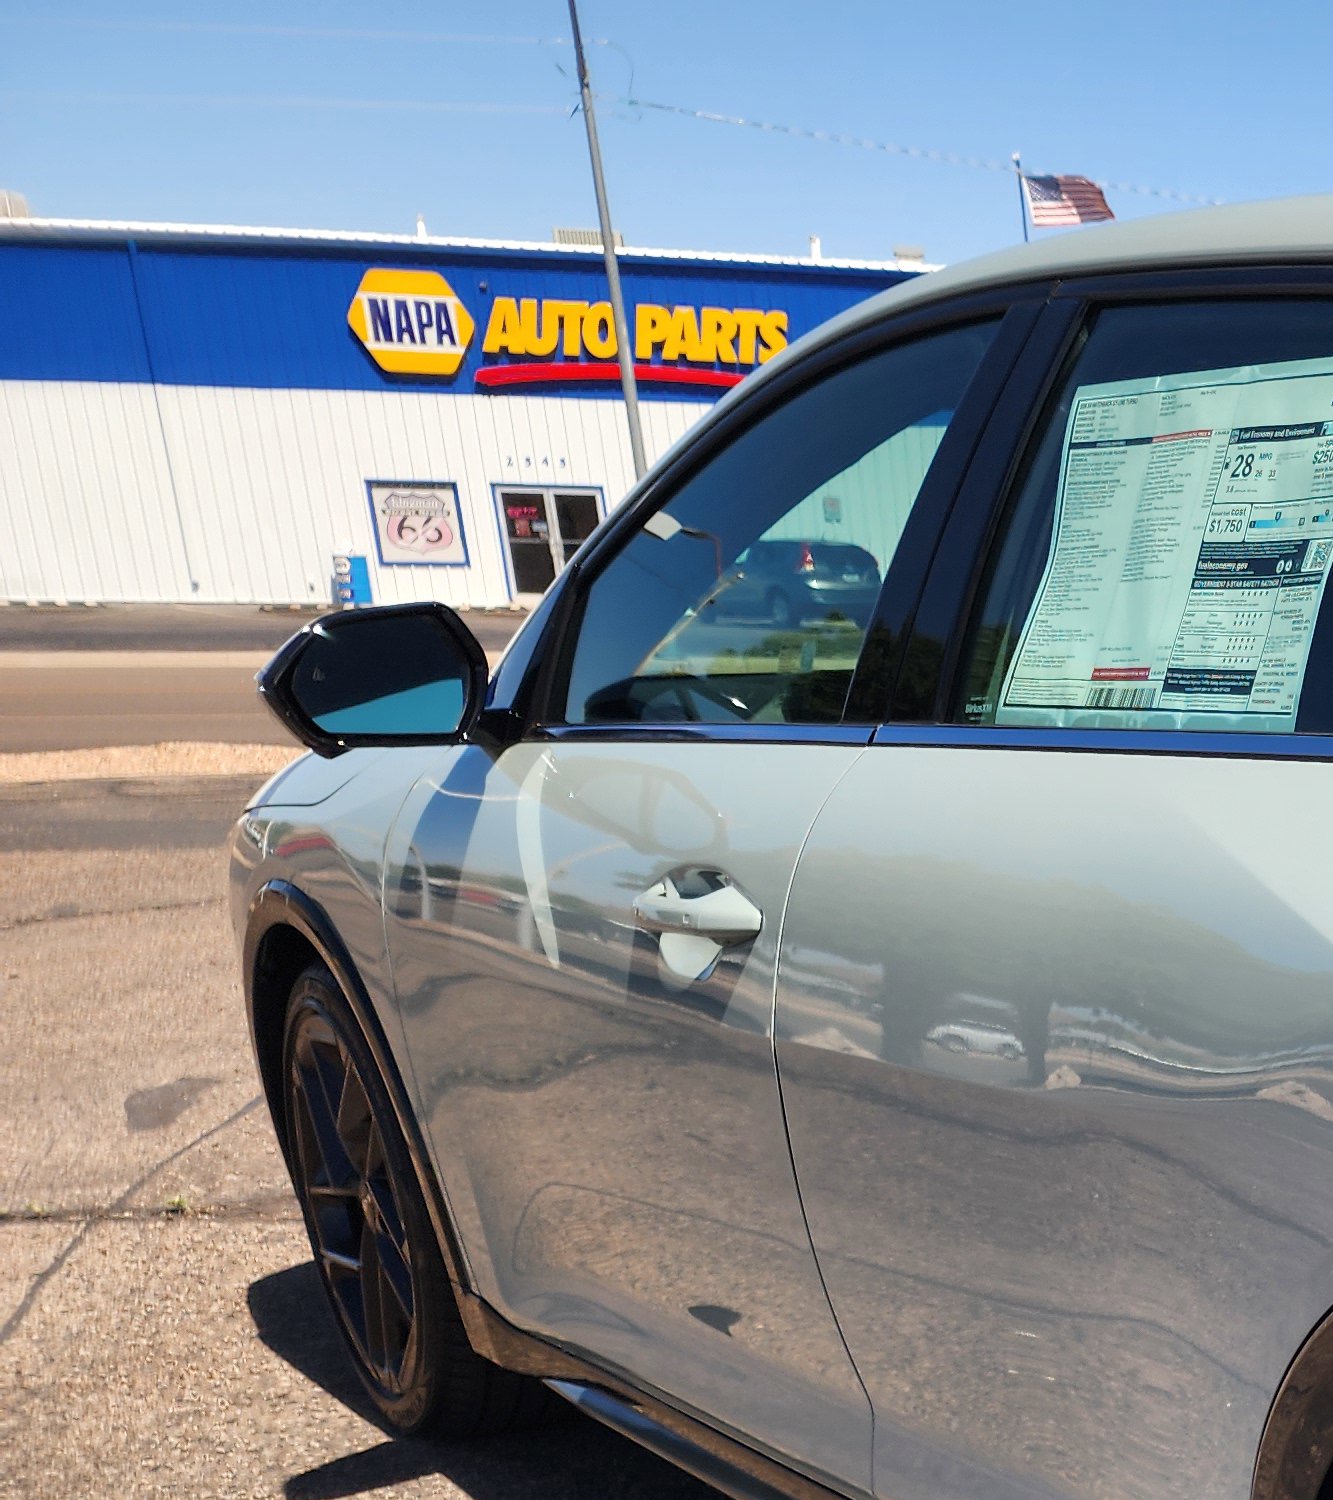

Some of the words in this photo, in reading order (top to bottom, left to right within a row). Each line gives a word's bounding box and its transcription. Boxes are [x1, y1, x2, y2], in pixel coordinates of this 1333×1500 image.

[368, 298, 456, 346] NAPA
[482, 296, 618, 358] AUTO
[635, 303, 788, 365] PARTS
[1230, 453, 1254, 478] 28
[1231, 507, 1248, 516] cost
[1209, 519, 1243, 534] $1,750
